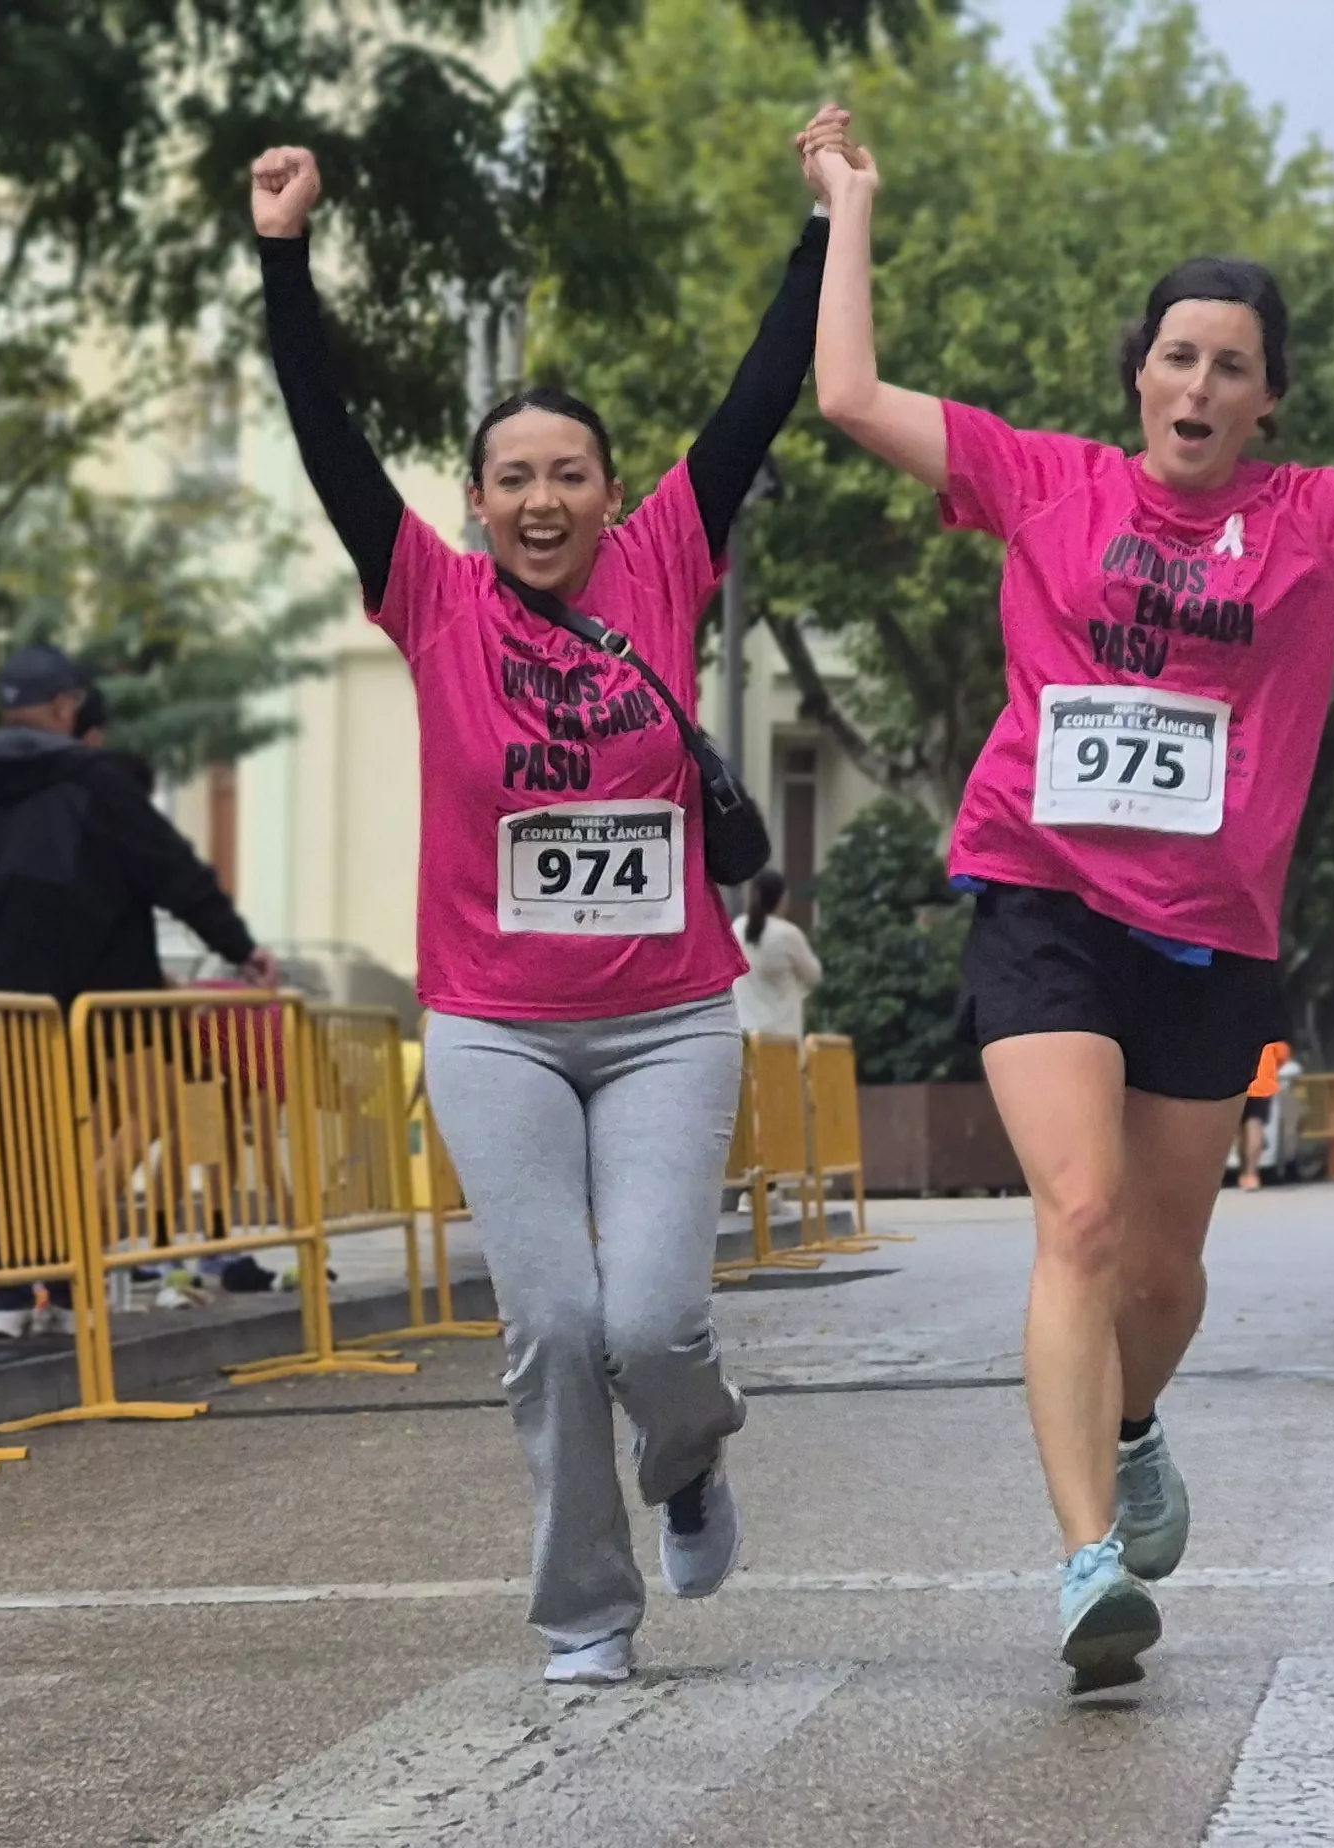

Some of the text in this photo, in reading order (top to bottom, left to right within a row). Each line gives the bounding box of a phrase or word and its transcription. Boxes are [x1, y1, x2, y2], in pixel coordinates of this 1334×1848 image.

[1136, 582, 1174, 630] EN
[1062, 713, 1206, 738] CONTRA EL CÁNCER
[1076, 736, 1186, 790] 975
[520, 824, 664, 841] CONTRA EL CÁNCER
[536, 847, 648, 897] 974
